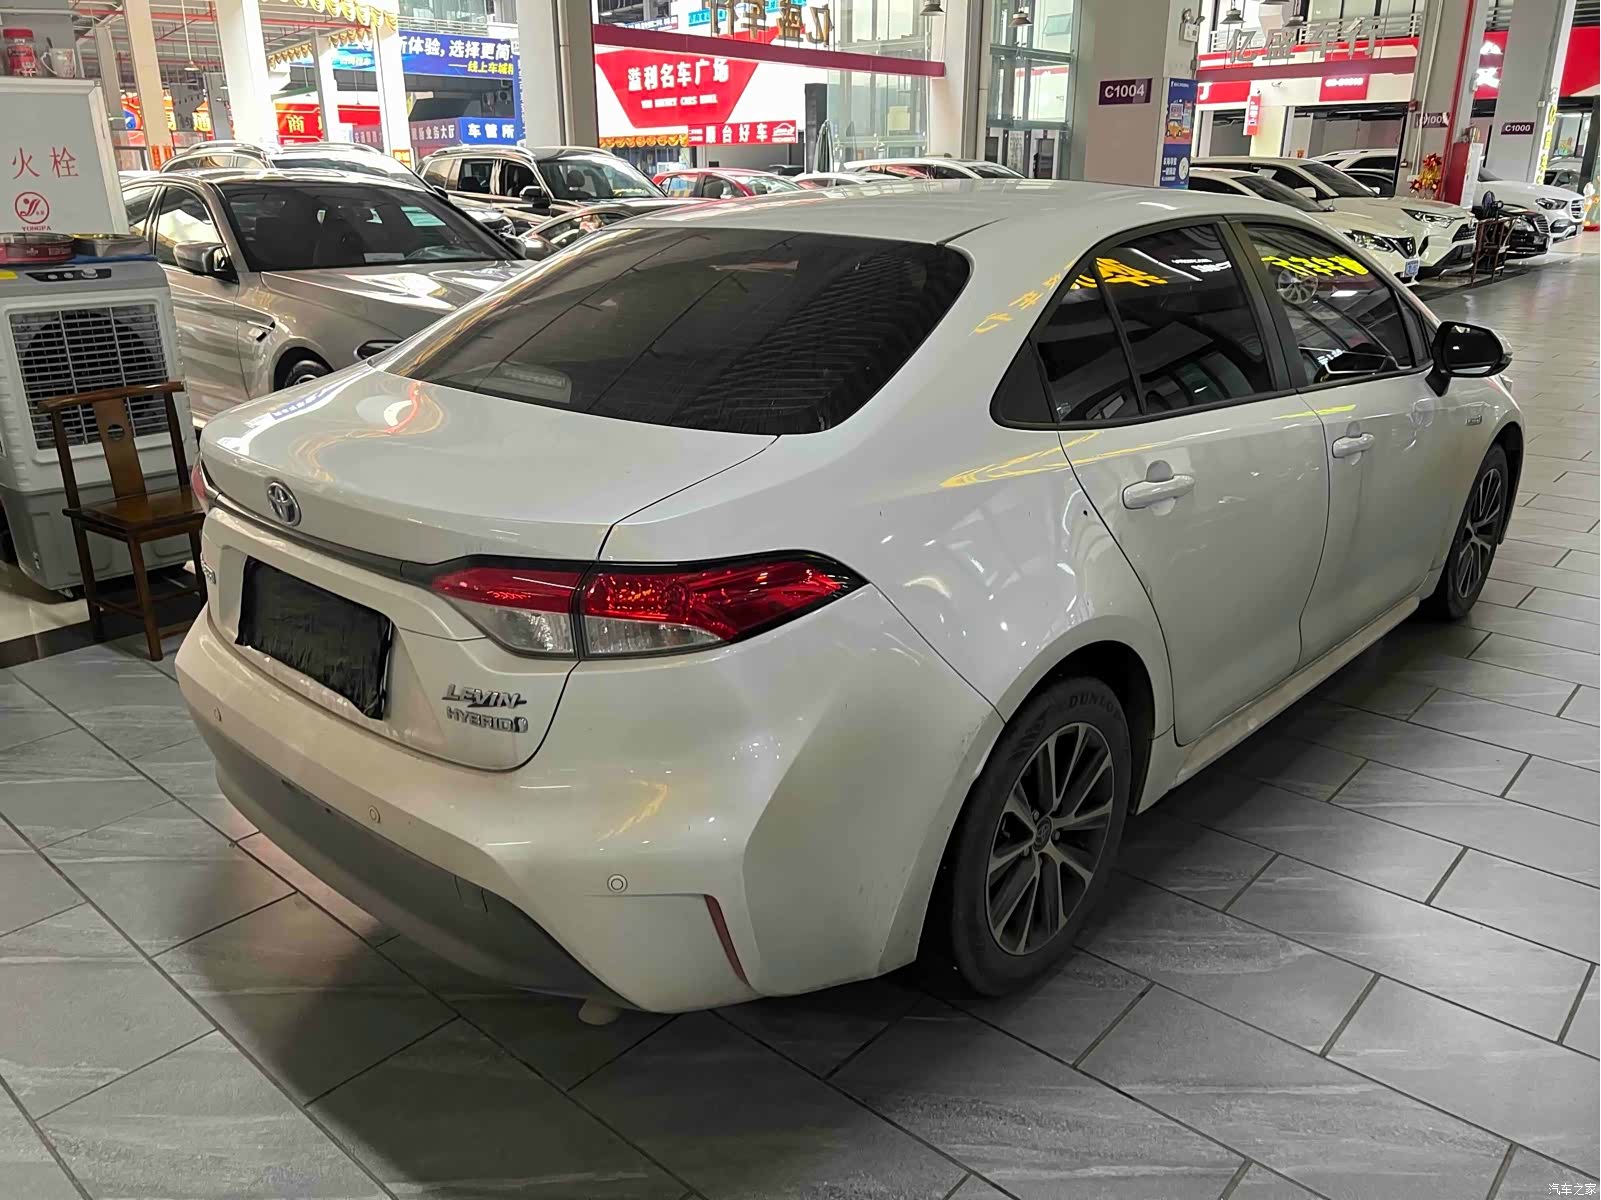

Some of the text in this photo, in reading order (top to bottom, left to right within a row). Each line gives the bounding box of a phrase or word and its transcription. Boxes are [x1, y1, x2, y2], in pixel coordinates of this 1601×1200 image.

[1227, 17, 1382, 63] 亿盛车行
[1104, 84, 1145, 98] C1004
[468, 123, 514, 139] 车管所
[1505, 124, 1531, 132] C1000
[12, 147, 79, 179] 火栓
[443, 683, 524, 709] LEVIN
[447, 706, 514, 732] HYBRID
